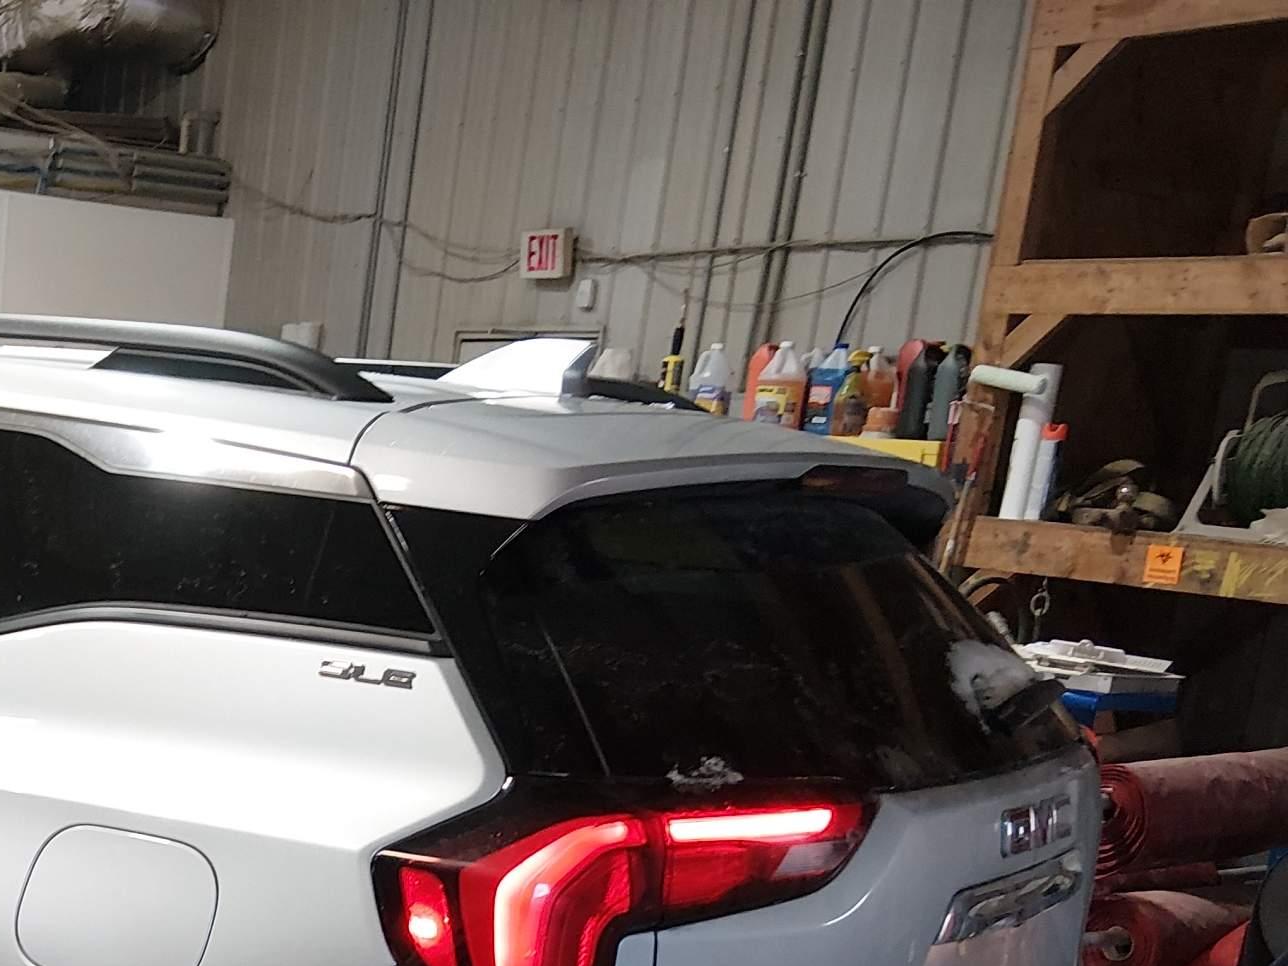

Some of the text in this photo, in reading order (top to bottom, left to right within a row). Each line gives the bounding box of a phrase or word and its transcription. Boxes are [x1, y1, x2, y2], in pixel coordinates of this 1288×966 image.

[526, 233, 559, 272] EXIT
[317, 659, 417, 691] SLE
[999, 792, 1072, 859] GMC
